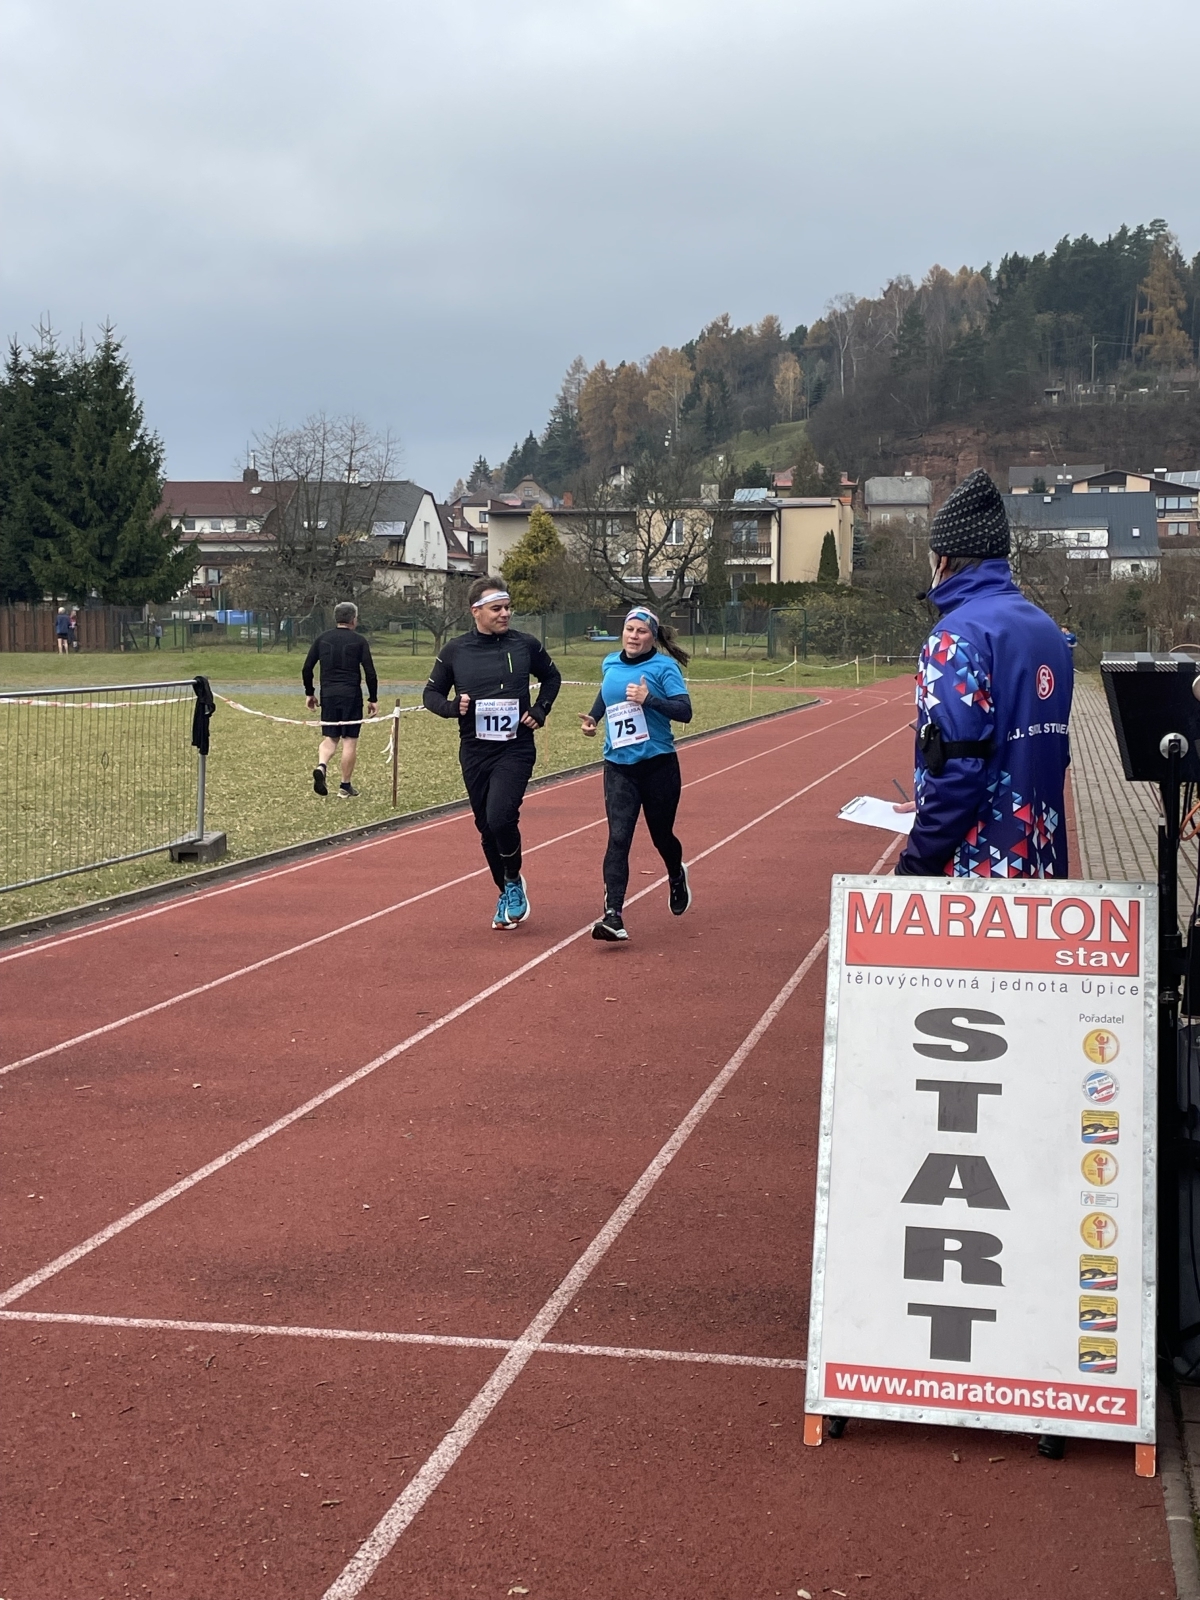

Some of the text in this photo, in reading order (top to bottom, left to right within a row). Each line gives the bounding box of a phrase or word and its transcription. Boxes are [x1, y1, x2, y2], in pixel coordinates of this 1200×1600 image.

[483, 715, 512, 732] 112
[614, 717, 637, 738] 75
[847, 892, 1140, 943] MARATON
[1055, 947, 1130, 968] stav
[846, 971, 1139, 997] tělovýchovná jednota Úpice
[1079, 1013, 1125, 1024] Pořadatel
[900, 1007, 1010, 1362] START
[835, 1371, 1127, 1417] www.maratonstav.cz
